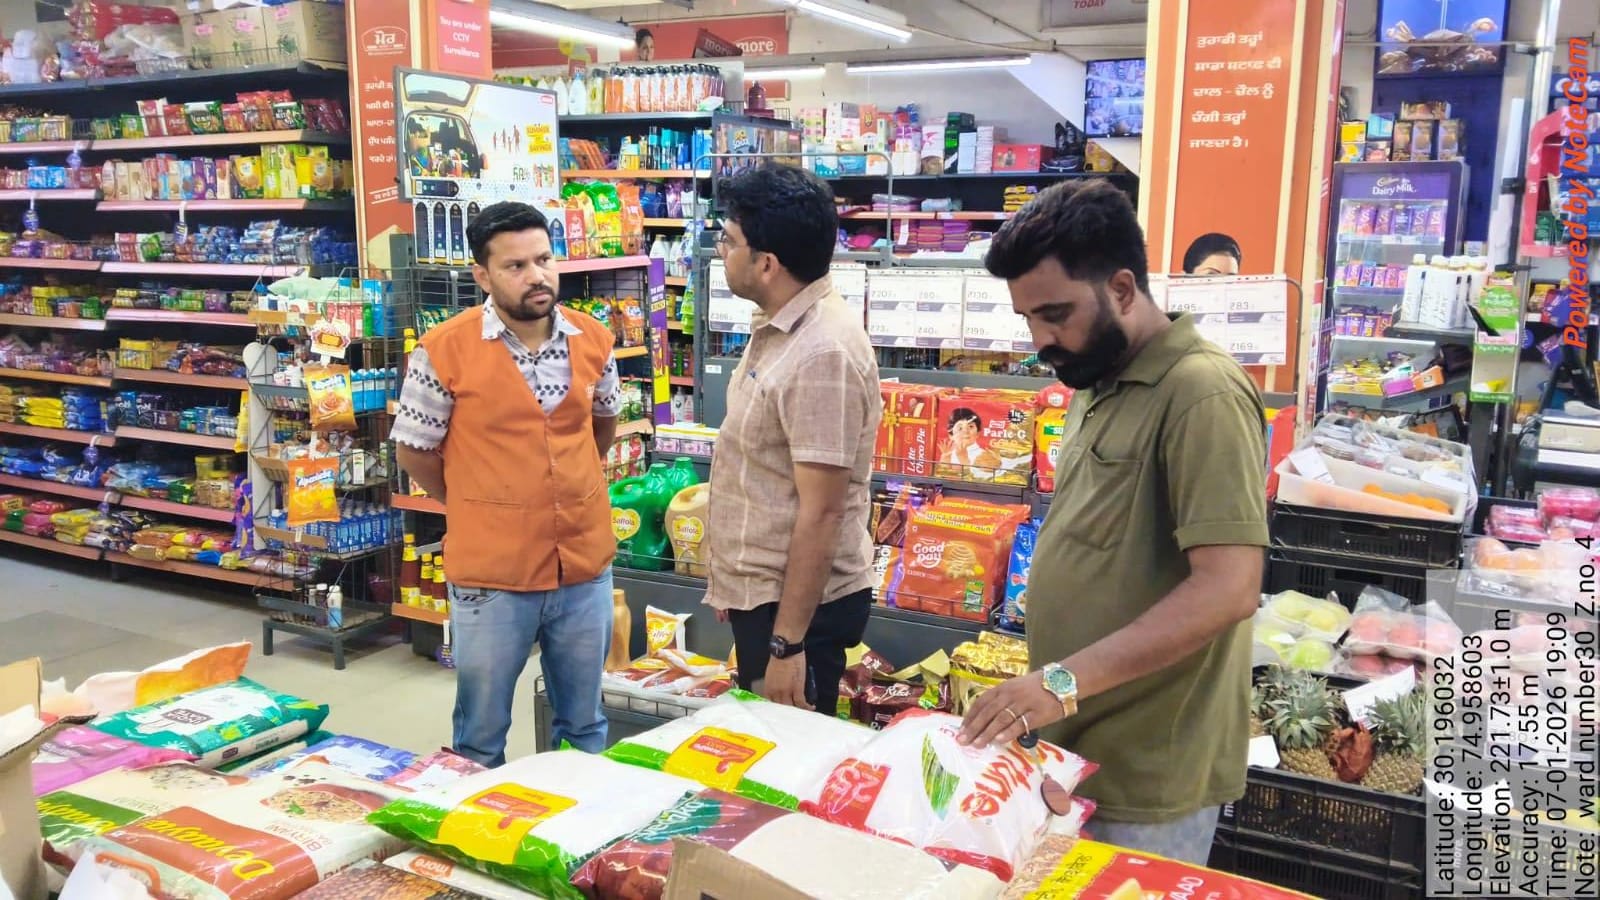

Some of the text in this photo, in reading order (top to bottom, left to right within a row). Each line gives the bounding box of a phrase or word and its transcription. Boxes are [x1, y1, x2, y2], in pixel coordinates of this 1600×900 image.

[453, 32, 471, 43] CCTV
[737, 39, 775, 53] more
[1372, 186, 1396, 196] Dairy
[912, 541, 945, 554] Good
[917, 553, 941, 565] Day
